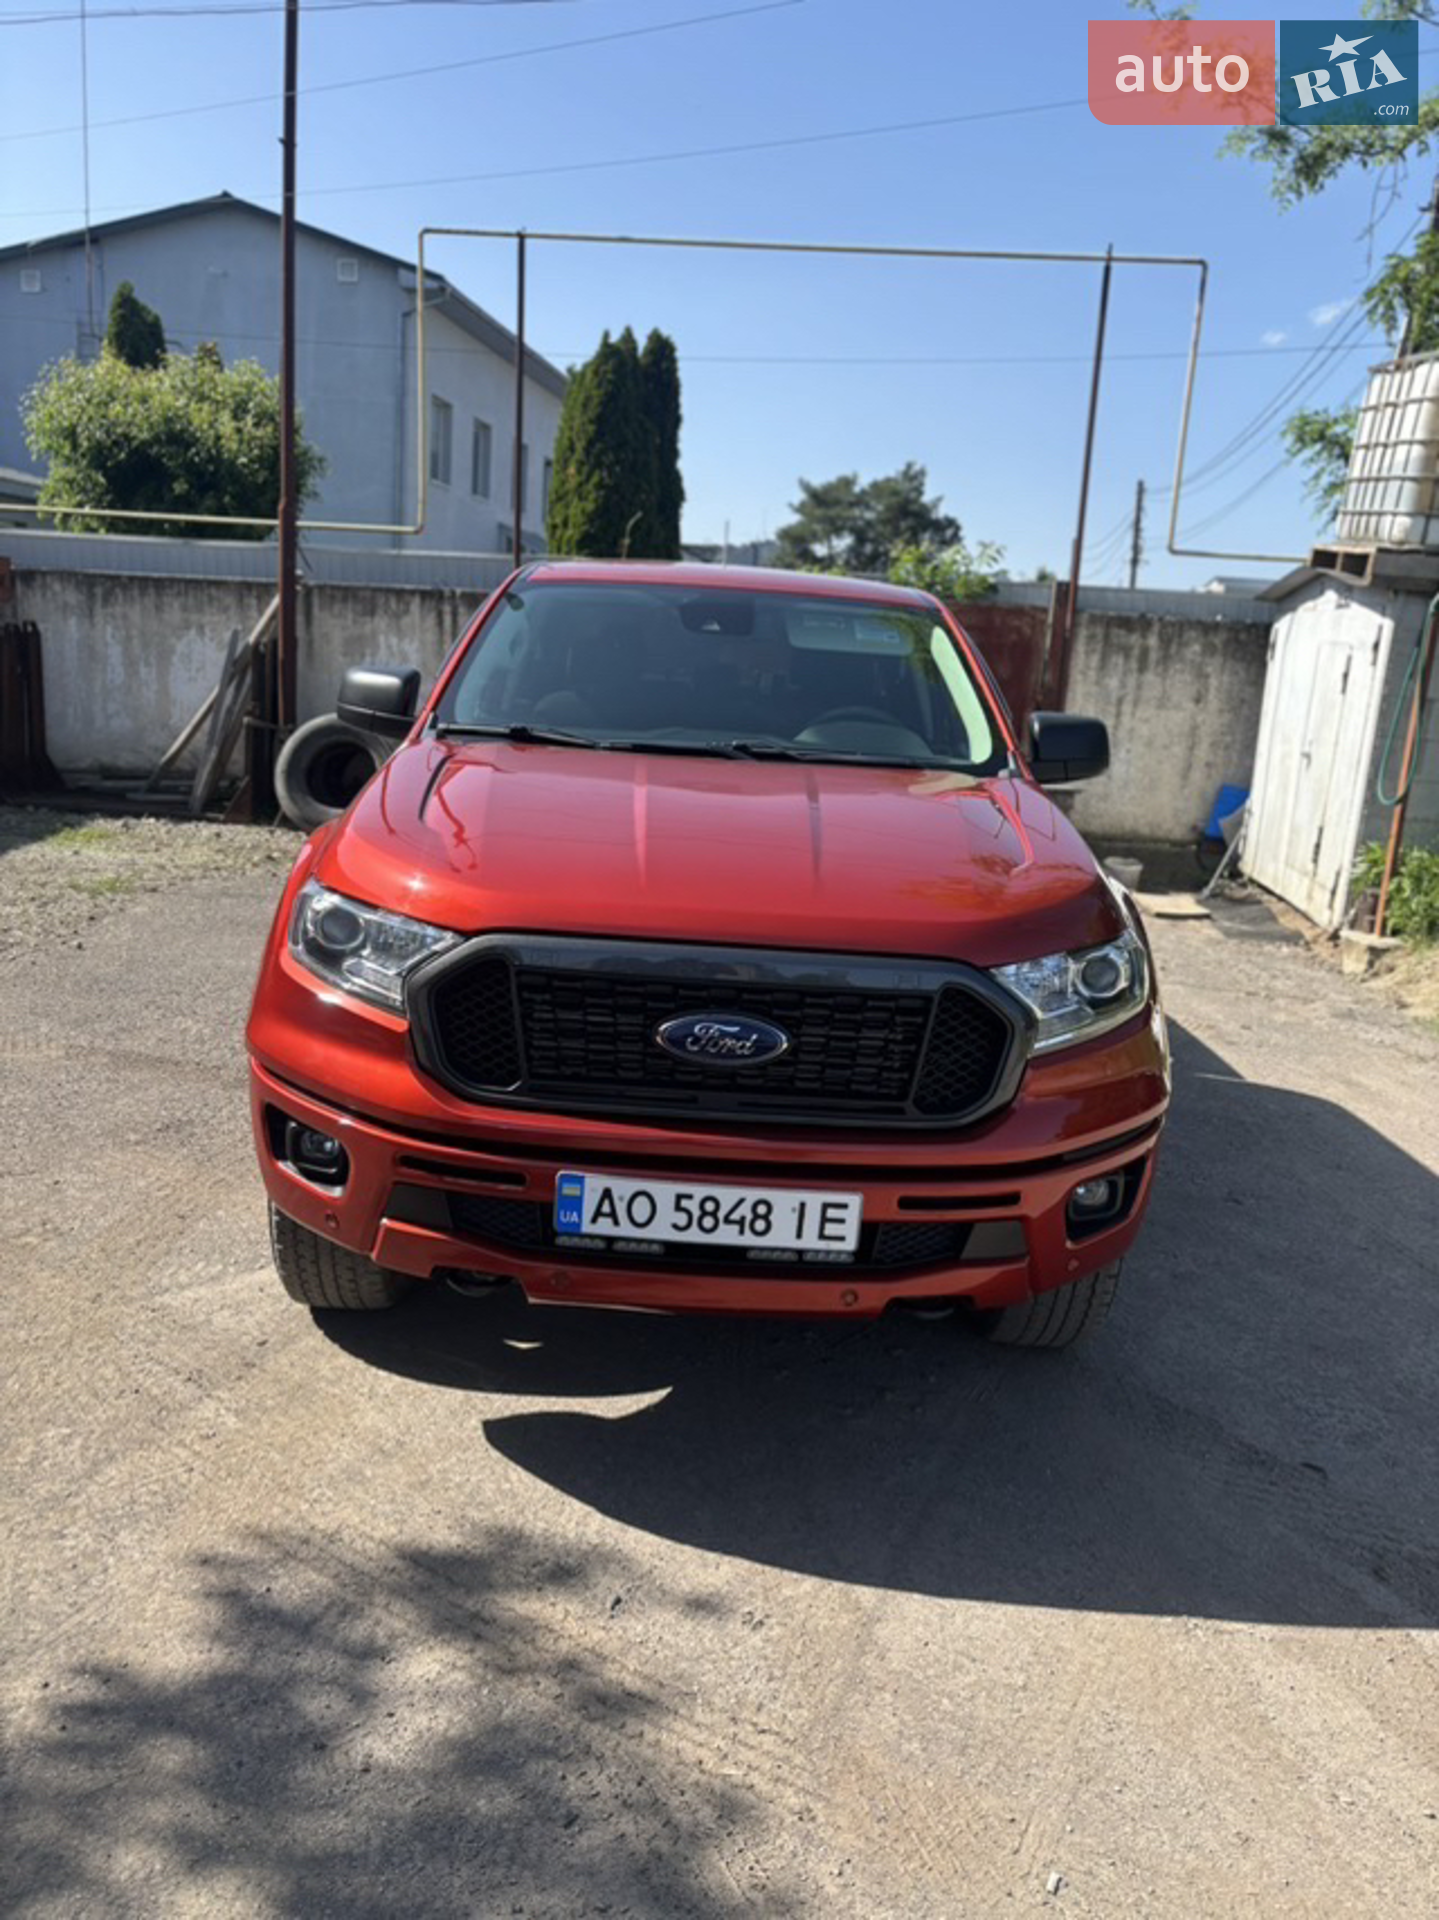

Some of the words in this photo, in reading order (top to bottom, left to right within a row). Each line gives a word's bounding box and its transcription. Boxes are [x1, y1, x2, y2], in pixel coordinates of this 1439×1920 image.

[685, 1022, 758, 1055] Ford
[560, 1210, 580, 1224] UA
[590, 1187, 657, 1229] AO
[671, 1193, 774, 1237] 5848
[795, 1202, 849, 1241] IE
